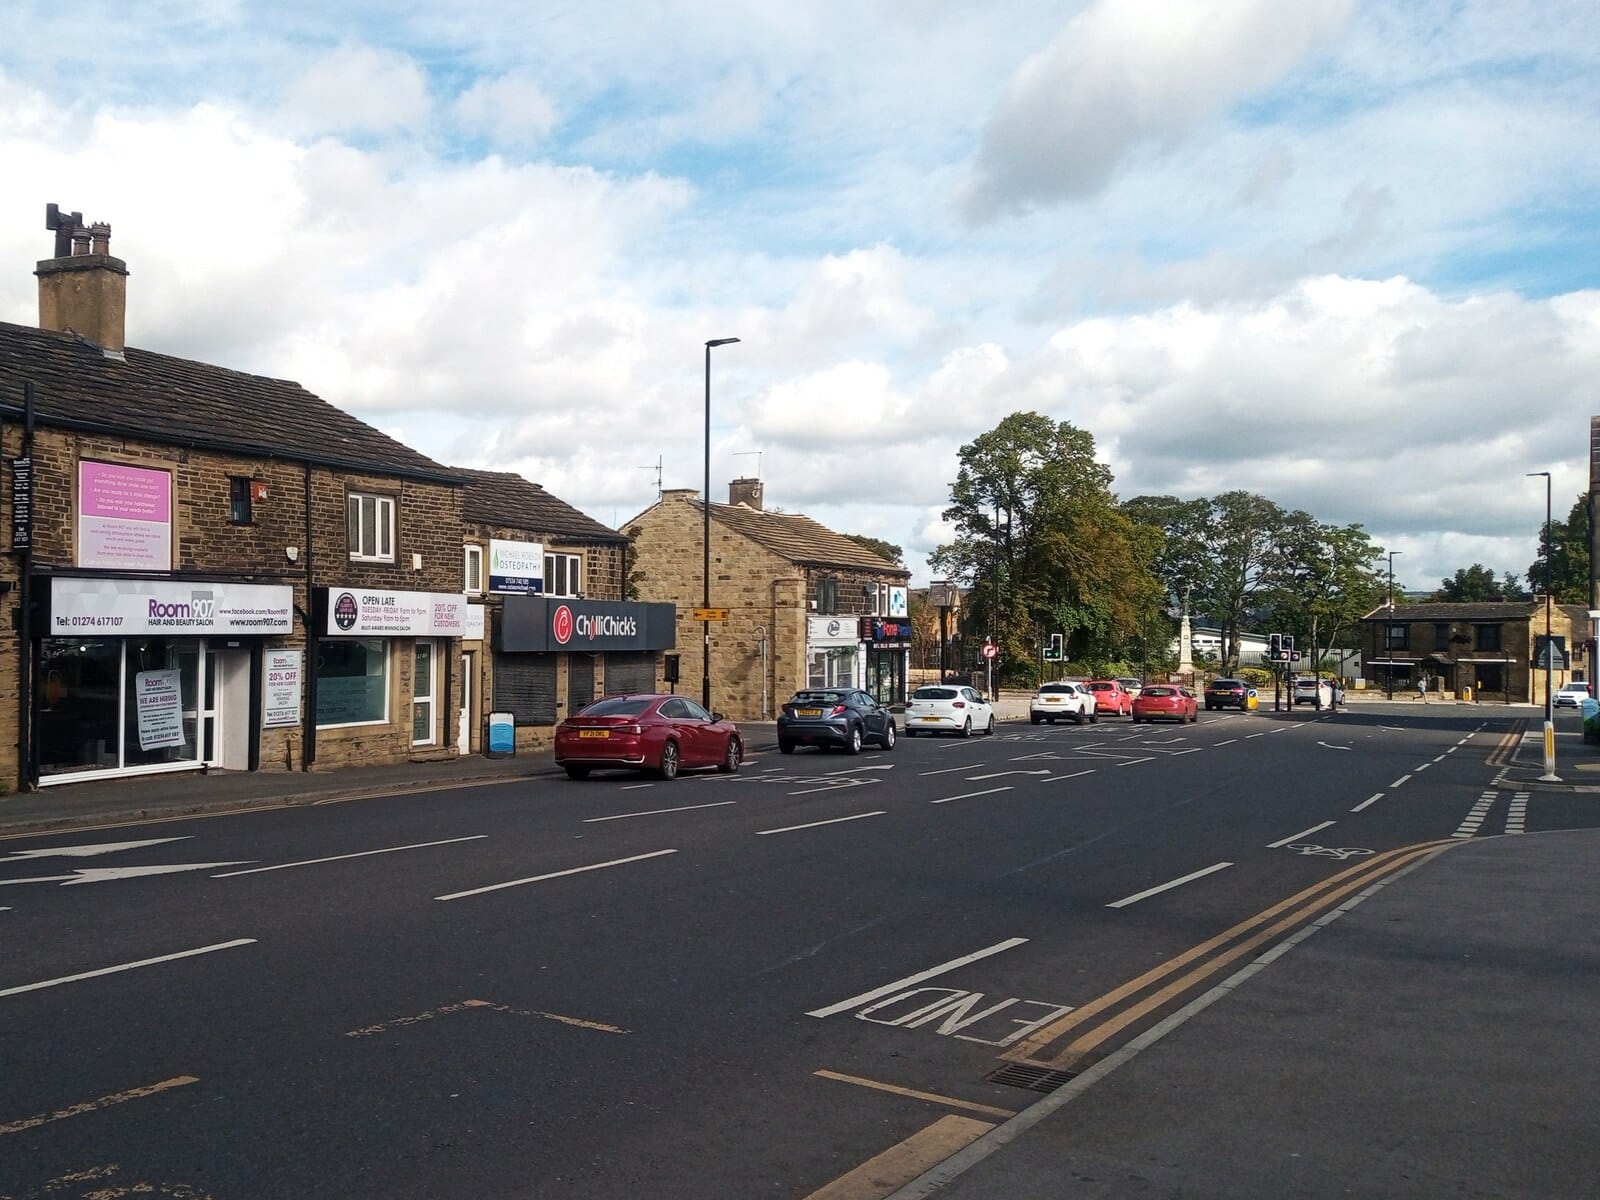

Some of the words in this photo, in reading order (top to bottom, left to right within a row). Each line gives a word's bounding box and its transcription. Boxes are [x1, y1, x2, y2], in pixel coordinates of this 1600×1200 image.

[362, 596, 380, 605] OPEN
[382, 597, 395, 606] LATE
[149, 599, 190, 618] Room
[56, 617, 70, 626] Tel:
[72, 617, 95, 626] 01274
[230, 618, 288, 626] www.room907.com
[362, 614, 382, 623] Saturday
[269, 672, 283, 680] 20%
[285, 672, 296, 680] OFF
[855, 988, 1075, 1047] END
